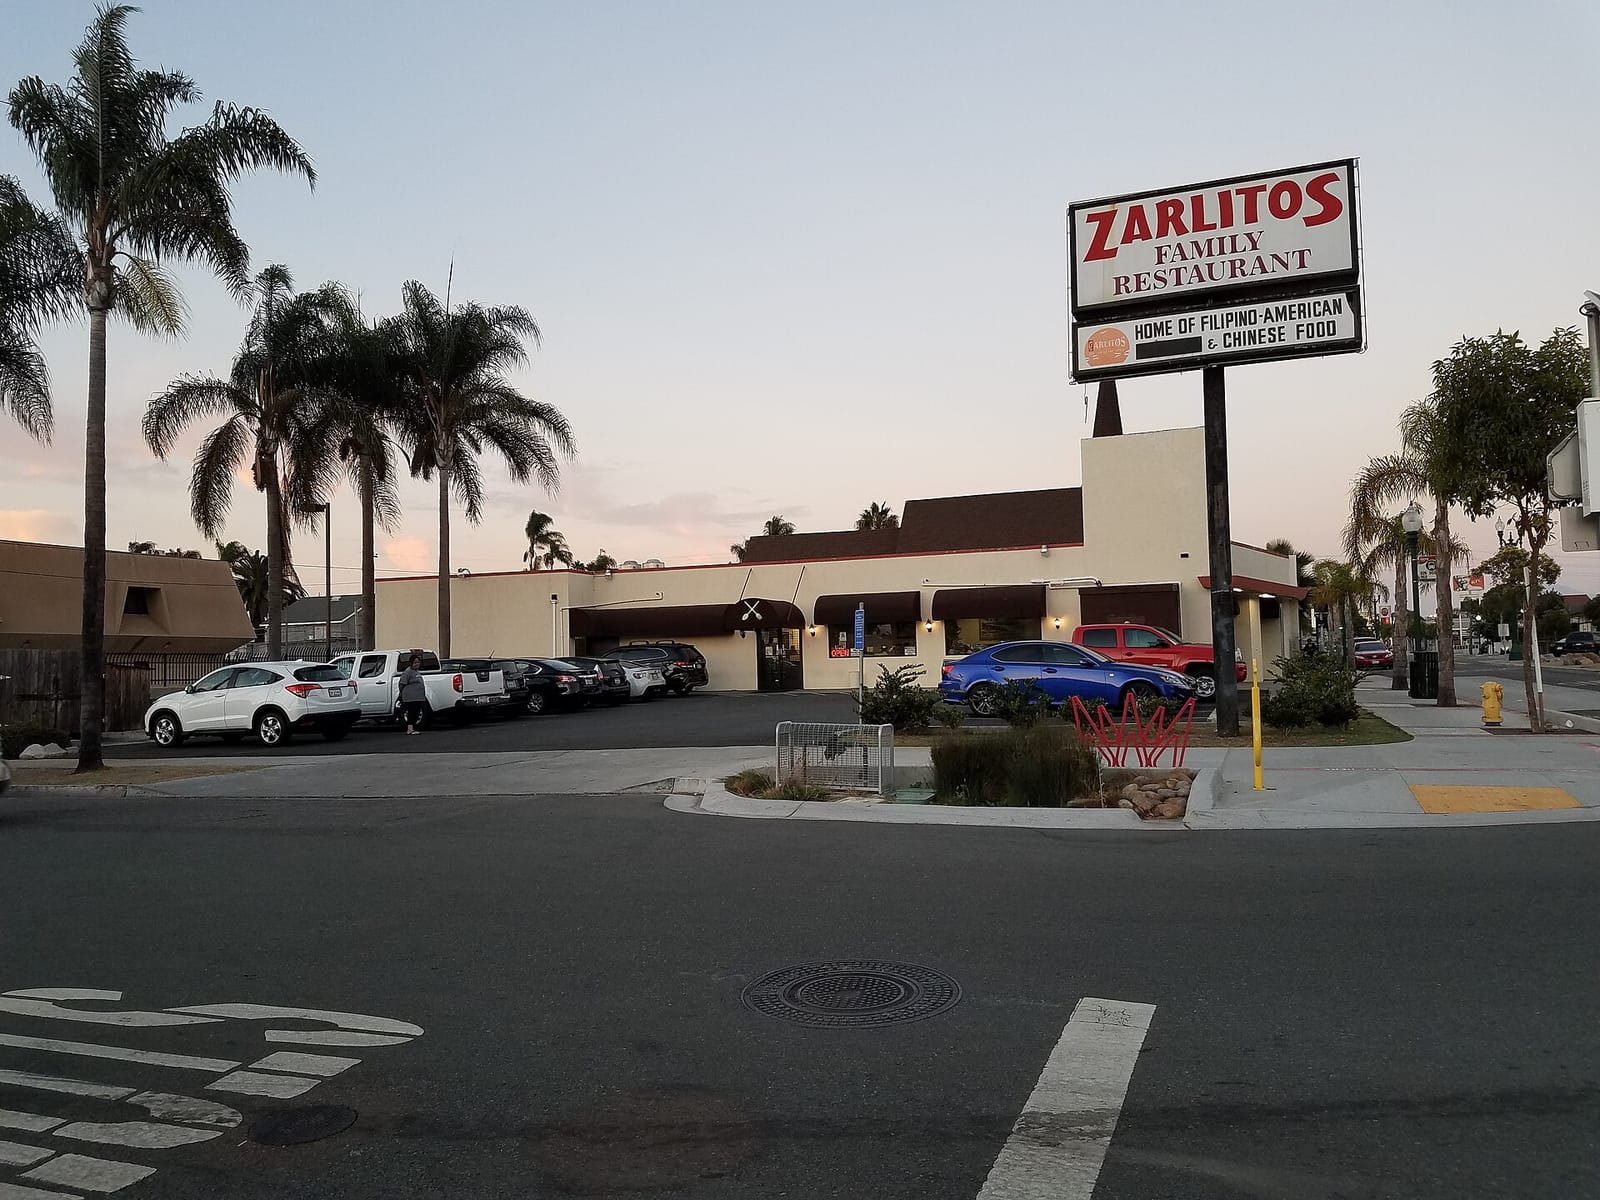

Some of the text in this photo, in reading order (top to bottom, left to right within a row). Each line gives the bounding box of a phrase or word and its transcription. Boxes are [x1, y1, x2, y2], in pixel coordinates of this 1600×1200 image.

[1083, 172, 1343, 262] ZARLITOS
[1155, 231, 1264, 265] FAMILY
[1113, 249, 1311, 296] RESTAURANT
[1135, 298, 1343, 340] HOME OF FILIPINO-AMERICAN
[1207, 320, 1337, 350] & CHINESE FOOD
[831, 649, 850, 657] OPEN
